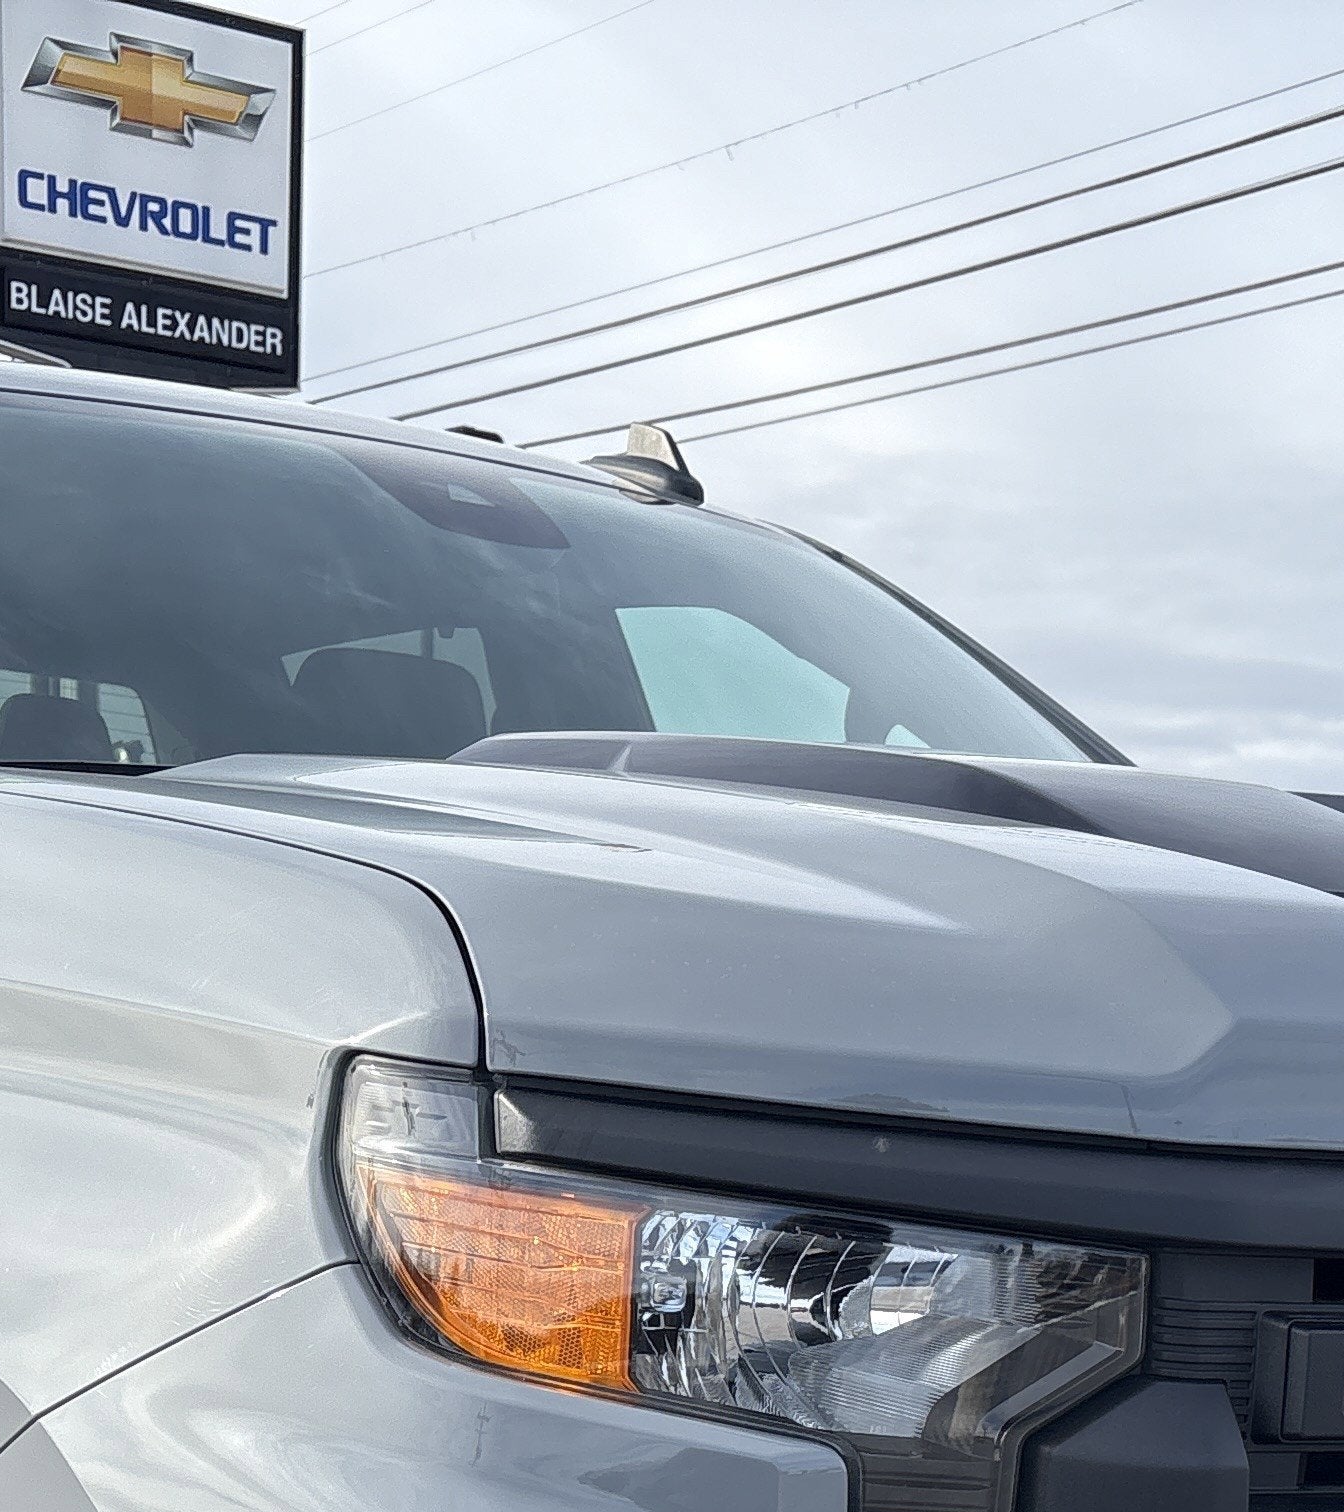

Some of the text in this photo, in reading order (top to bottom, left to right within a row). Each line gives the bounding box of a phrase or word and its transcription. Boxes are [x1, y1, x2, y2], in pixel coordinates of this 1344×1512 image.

[17, 168, 277, 256] CHEVROLET
[9, 279, 284, 357] BLAISE ALEXANDER
